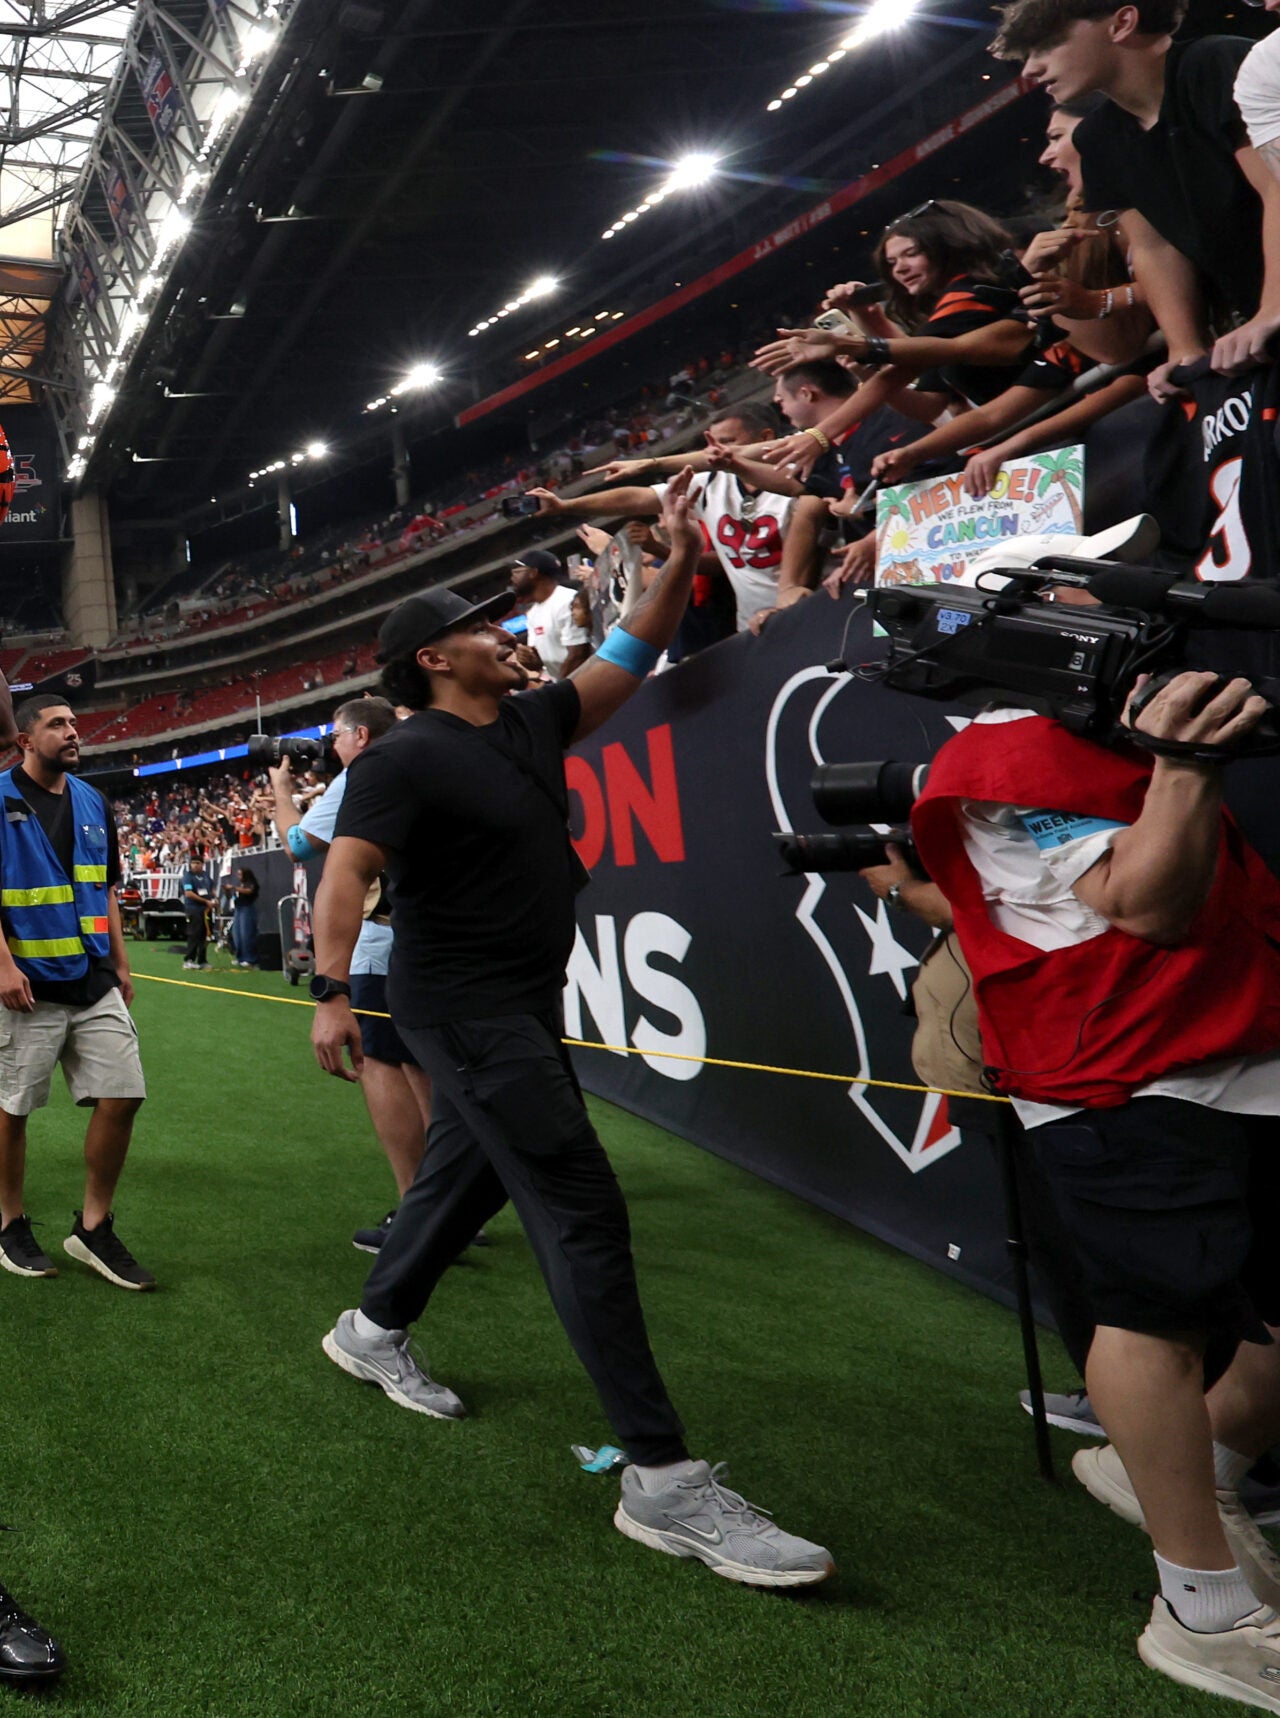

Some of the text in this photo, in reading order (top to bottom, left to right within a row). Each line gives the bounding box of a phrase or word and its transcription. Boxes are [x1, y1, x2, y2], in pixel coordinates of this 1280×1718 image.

[908, 468, 1041, 526] HEY OE!
[937, 510, 953, 522] WE
[988, 500, 1014, 511] FROM
[927, 510, 1019, 549] CANCÚN
[930, 560, 966, 582] YOU
